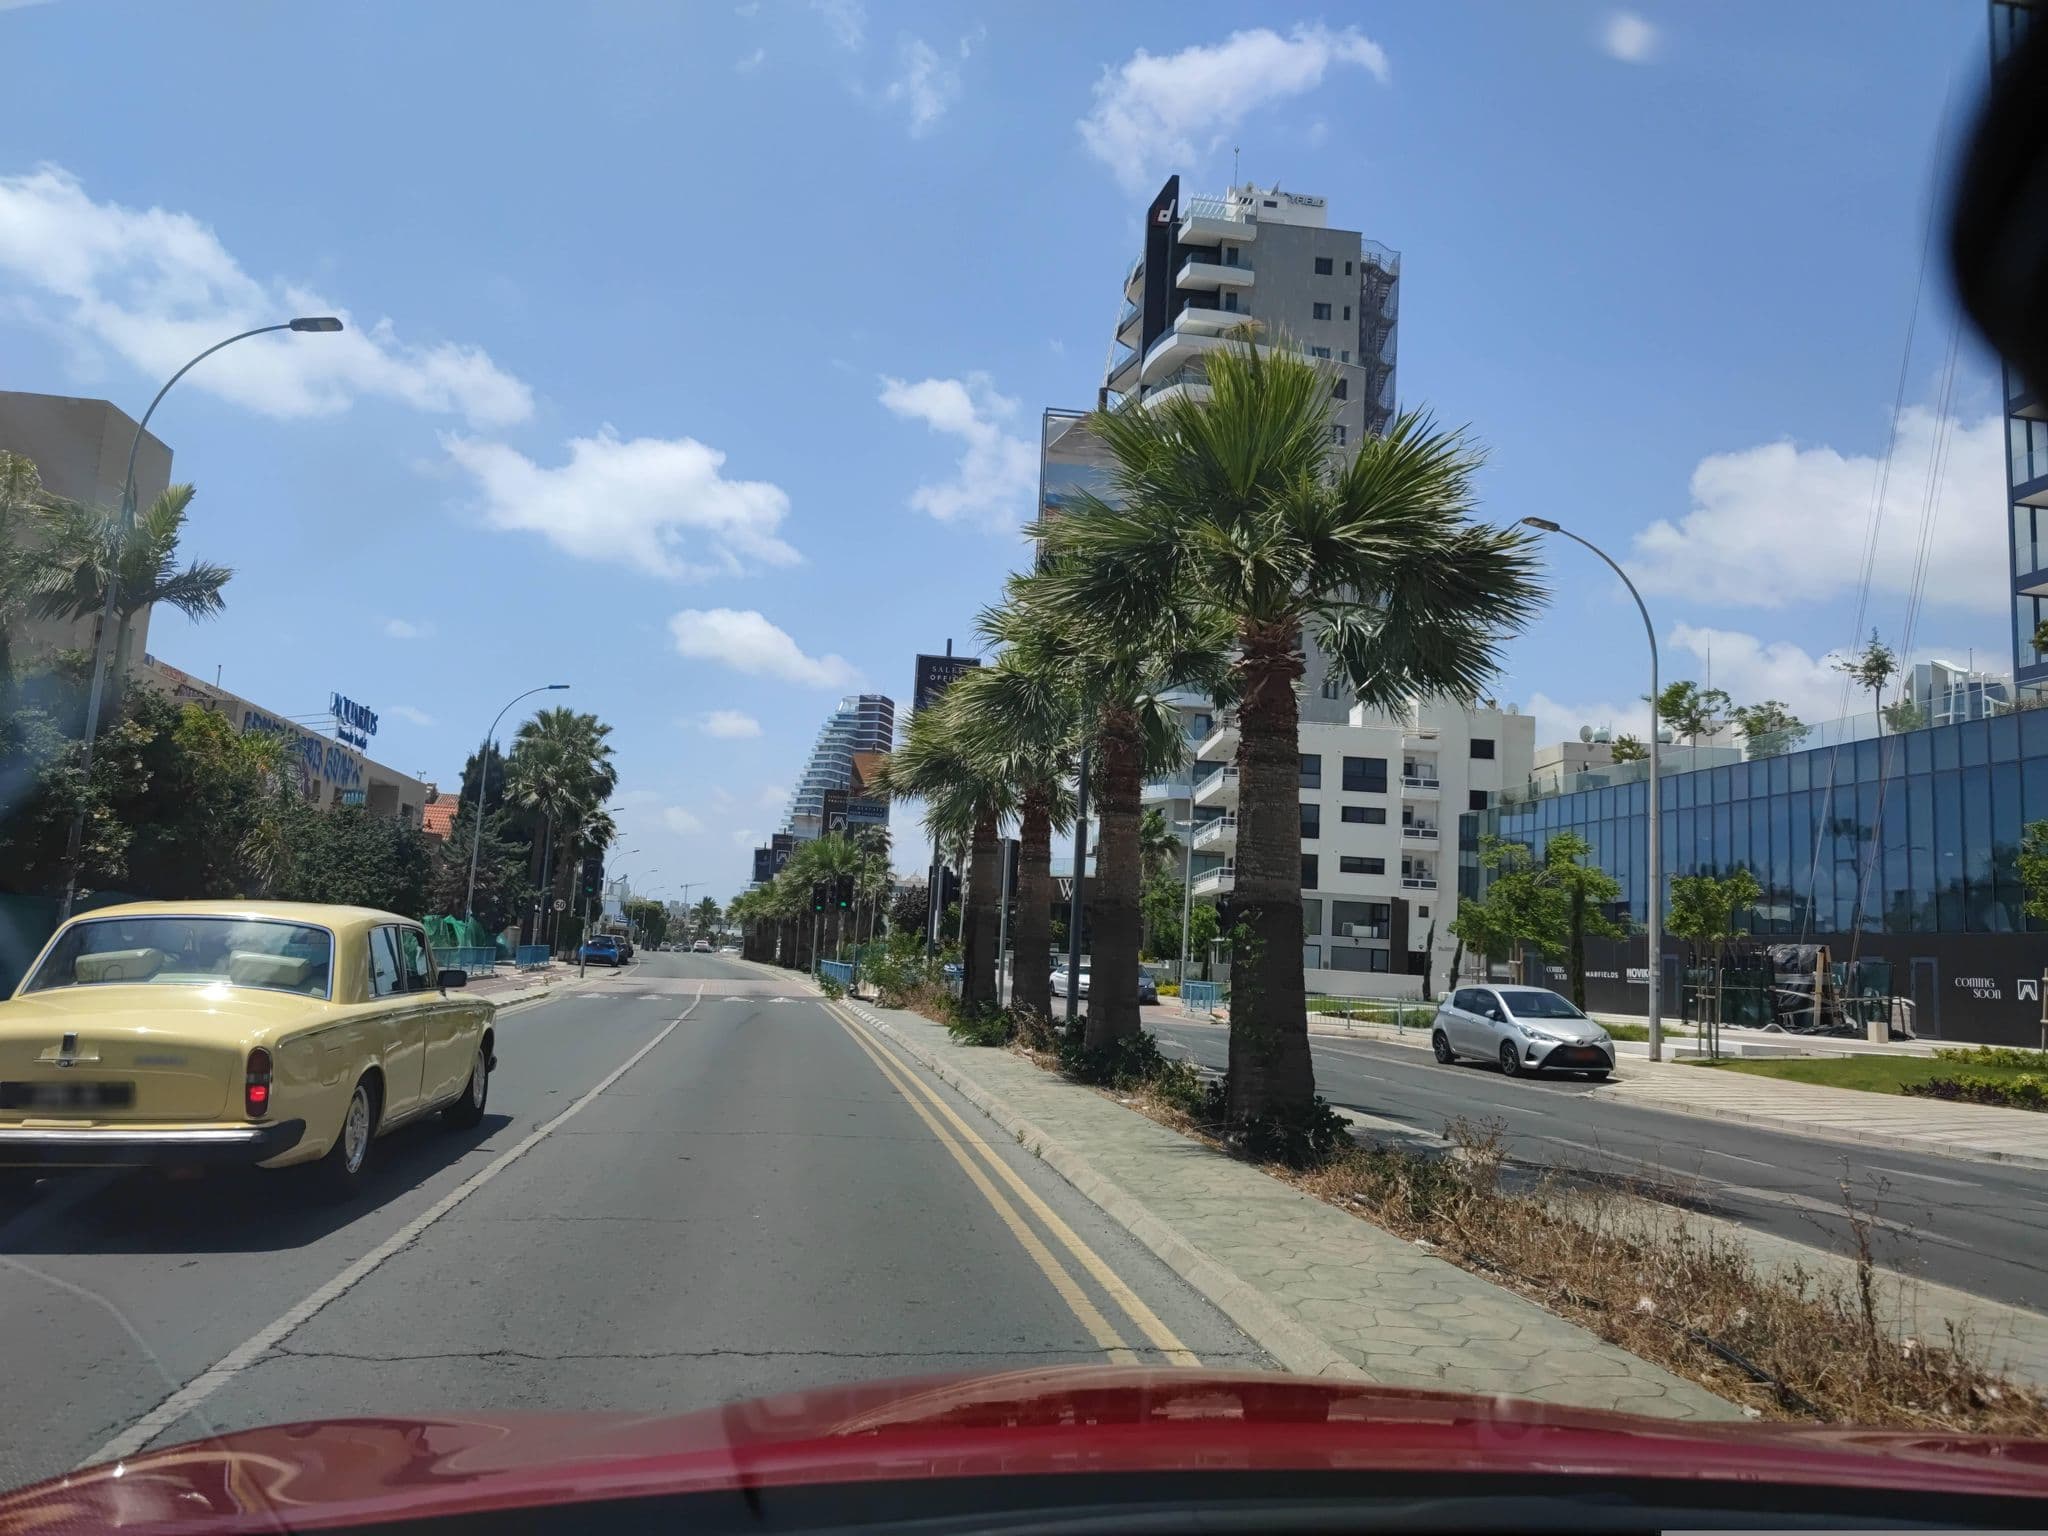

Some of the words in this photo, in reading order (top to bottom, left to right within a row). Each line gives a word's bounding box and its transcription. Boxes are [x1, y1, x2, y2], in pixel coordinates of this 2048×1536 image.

[1626, 968, 1650, 978] NOVIK
[1954, 977, 1995, 988] COMING
[1973, 988, 2001, 1000] SOON
